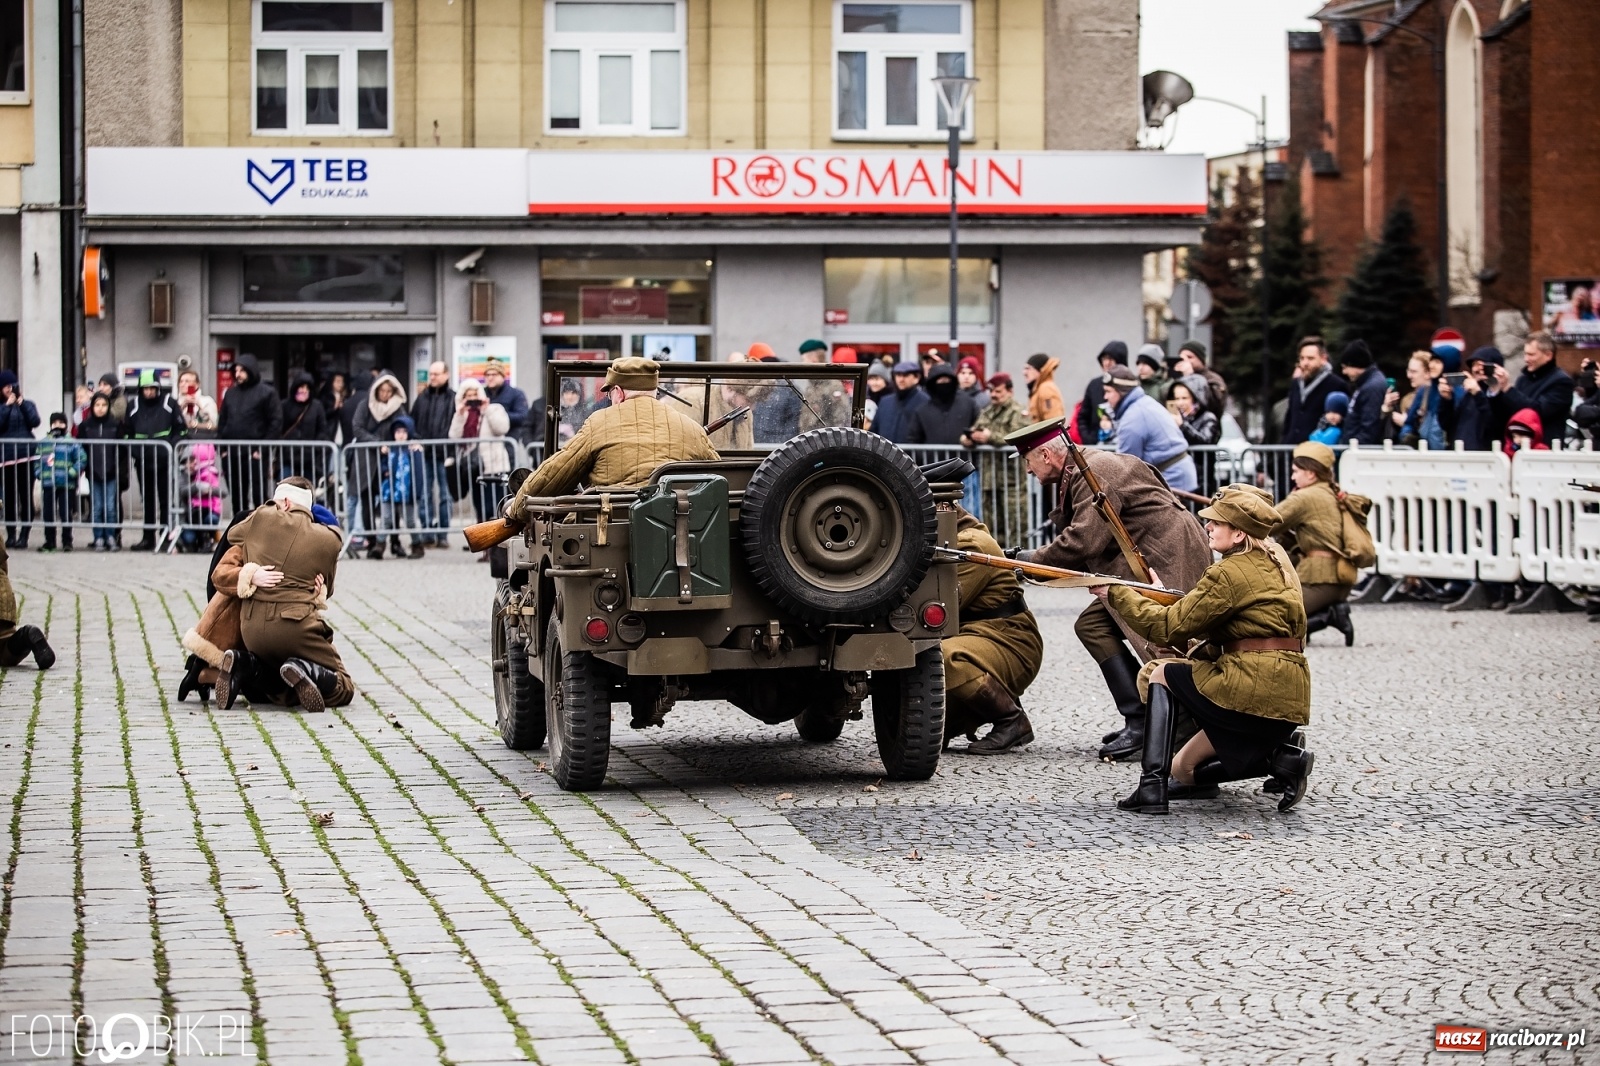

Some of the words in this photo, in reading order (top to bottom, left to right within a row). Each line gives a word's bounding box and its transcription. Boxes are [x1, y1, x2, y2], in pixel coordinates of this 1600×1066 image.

[302, 158, 369, 183] TEB
[712, 156, 1023, 198] ROSSMANN
[301, 188, 369, 198] EDUKACJA
